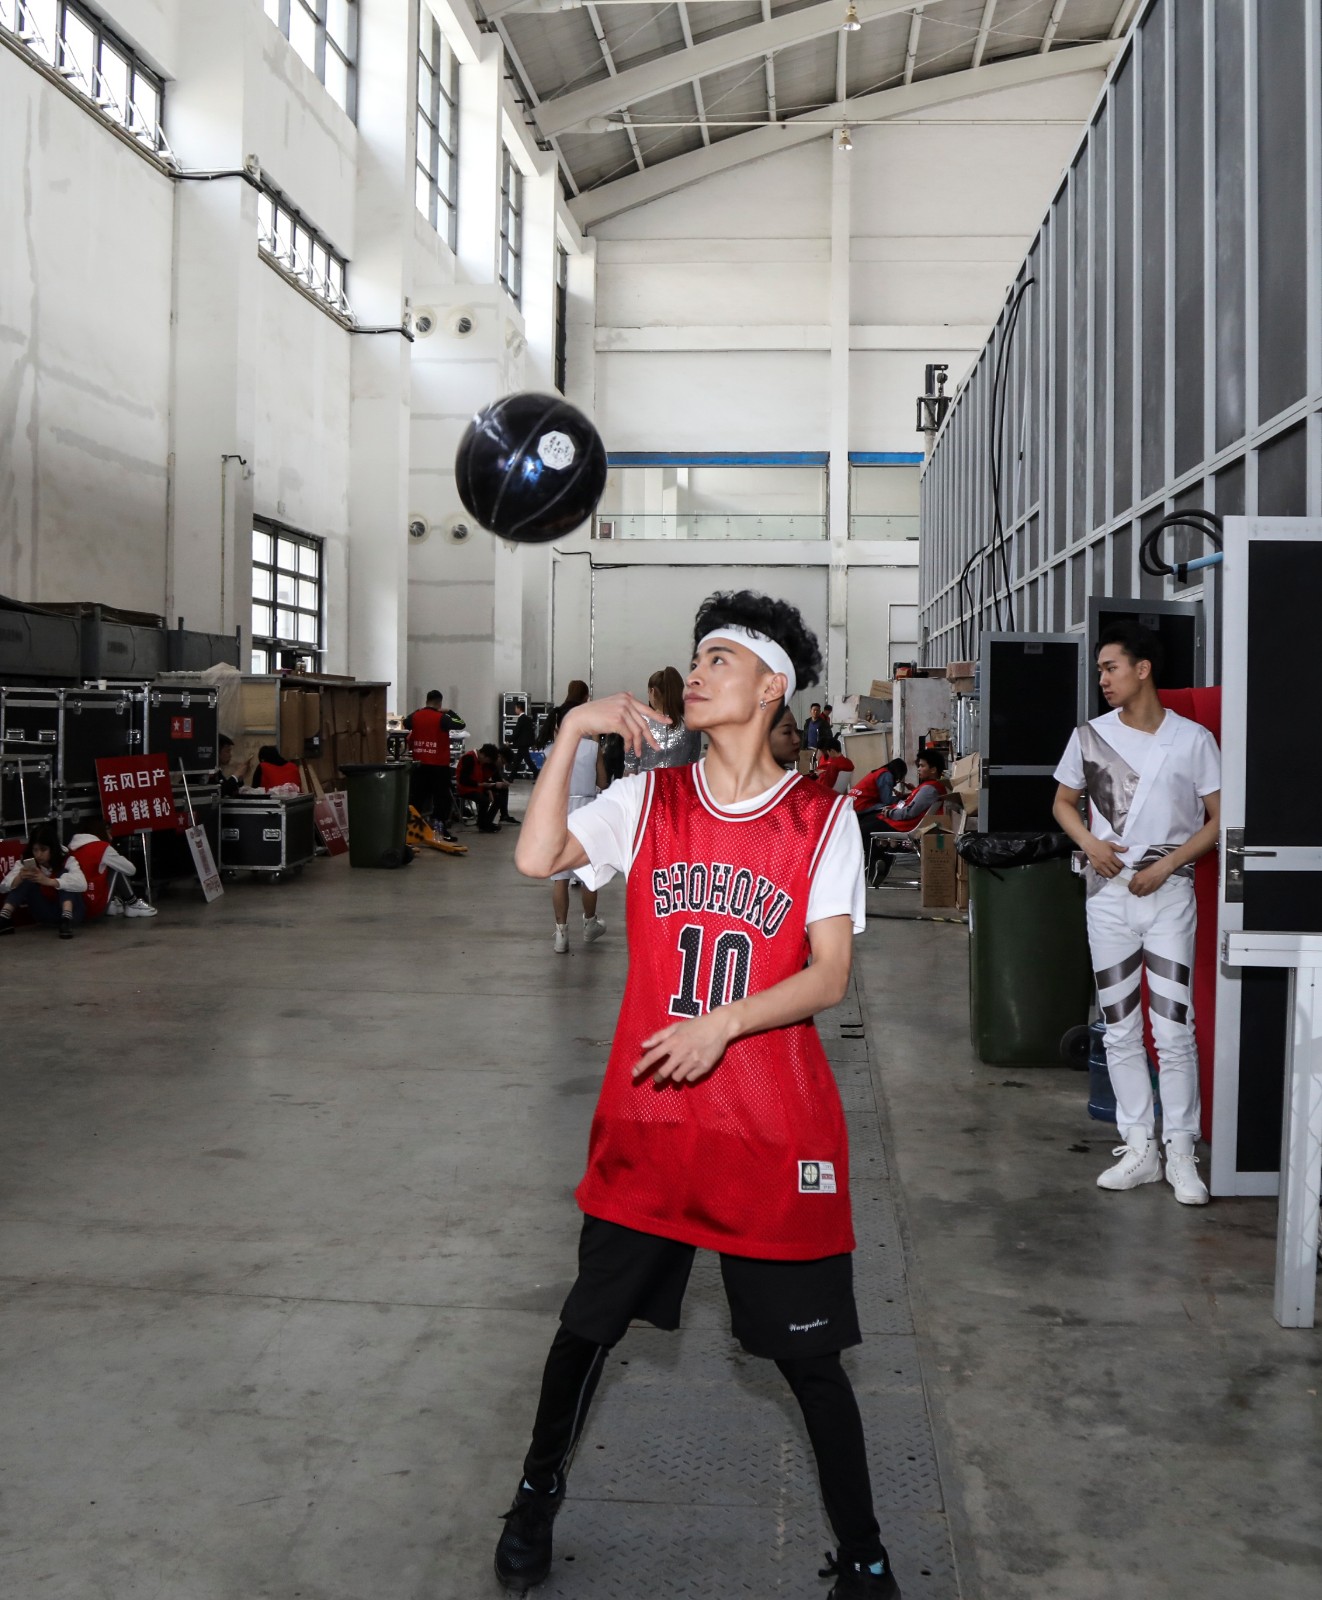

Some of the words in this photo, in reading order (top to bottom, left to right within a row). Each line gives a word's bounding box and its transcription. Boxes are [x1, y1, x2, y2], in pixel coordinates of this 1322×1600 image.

[103, 768, 166, 792] 东风日产
[108, 801, 128, 824] 省油
[131, 799, 150, 821] 省钱
[153, 796, 171, 818] 省心
[653, 862, 793, 939] SHOHOKU
[668, 923, 753, 1019] 10
